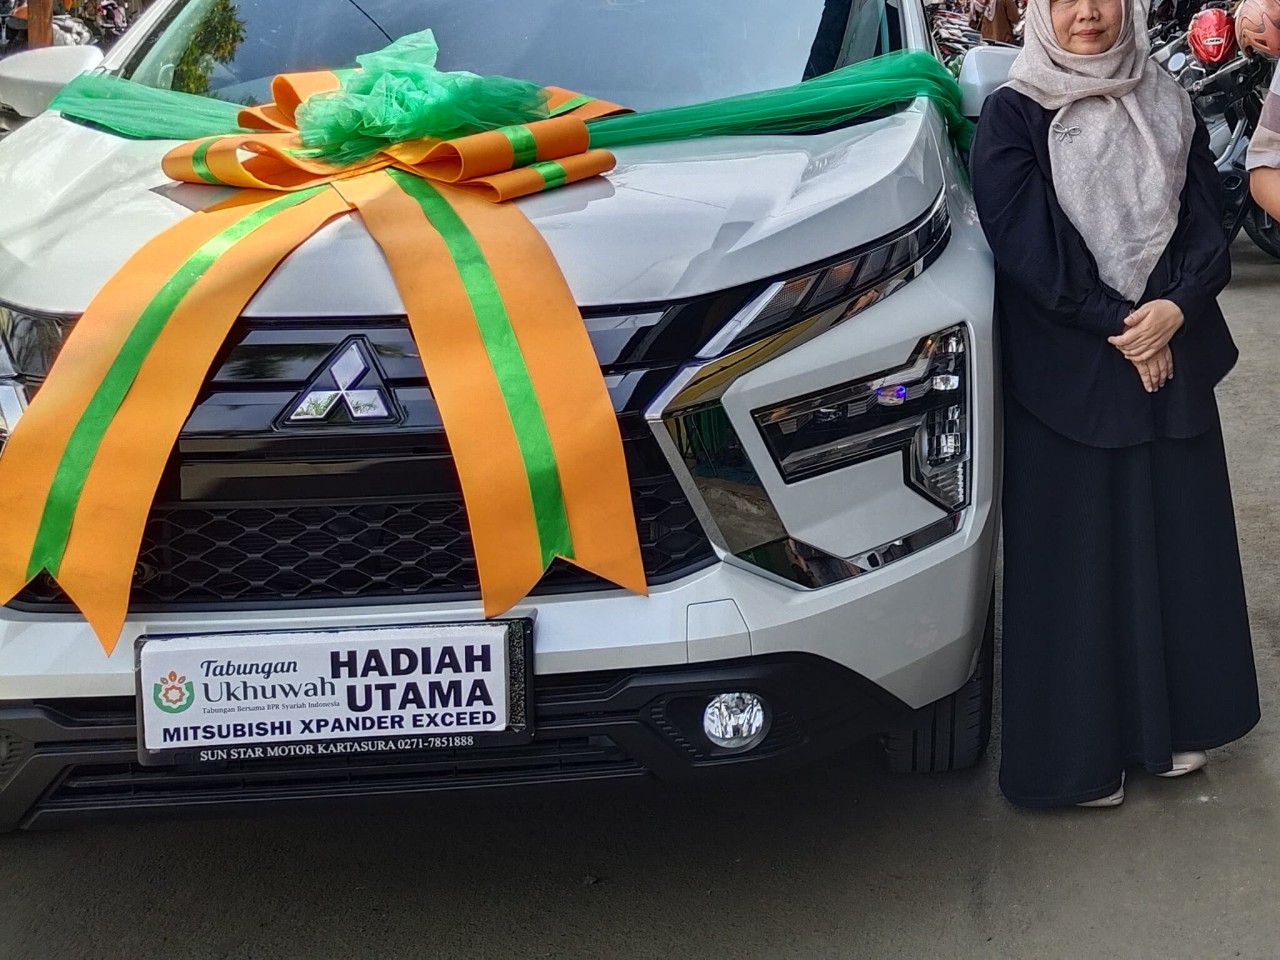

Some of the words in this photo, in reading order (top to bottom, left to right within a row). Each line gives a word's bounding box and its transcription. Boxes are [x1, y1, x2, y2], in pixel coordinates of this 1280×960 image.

[200, 659, 298, 679] Tabungan
[330, 644, 492, 679] HADIAH
[202, 676, 336, 703] Ukhuwah
[346, 679, 494, 713] UTAMA
[202, 707, 236, 715] Tabungan
[237, 705, 266, 713] Bersama
[267, 703, 280, 711] BPR
[281, 701, 307, 711] Syariah
[308, 700, 340, 708] Indonesia
[163, 720, 293, 743] MITSUBISHI
[300, 715, 401, 735] XPANDER
[411, 710, 497, 729] EXCEED
[200, 748, 228, 762] SUN
[230, 746, 265, 760] STAR
[266, 743, 316, 758] MOTOR
[317, 740, 397, 756] KARTASURA
[398, 735, 475, 751] 0271-7851888
